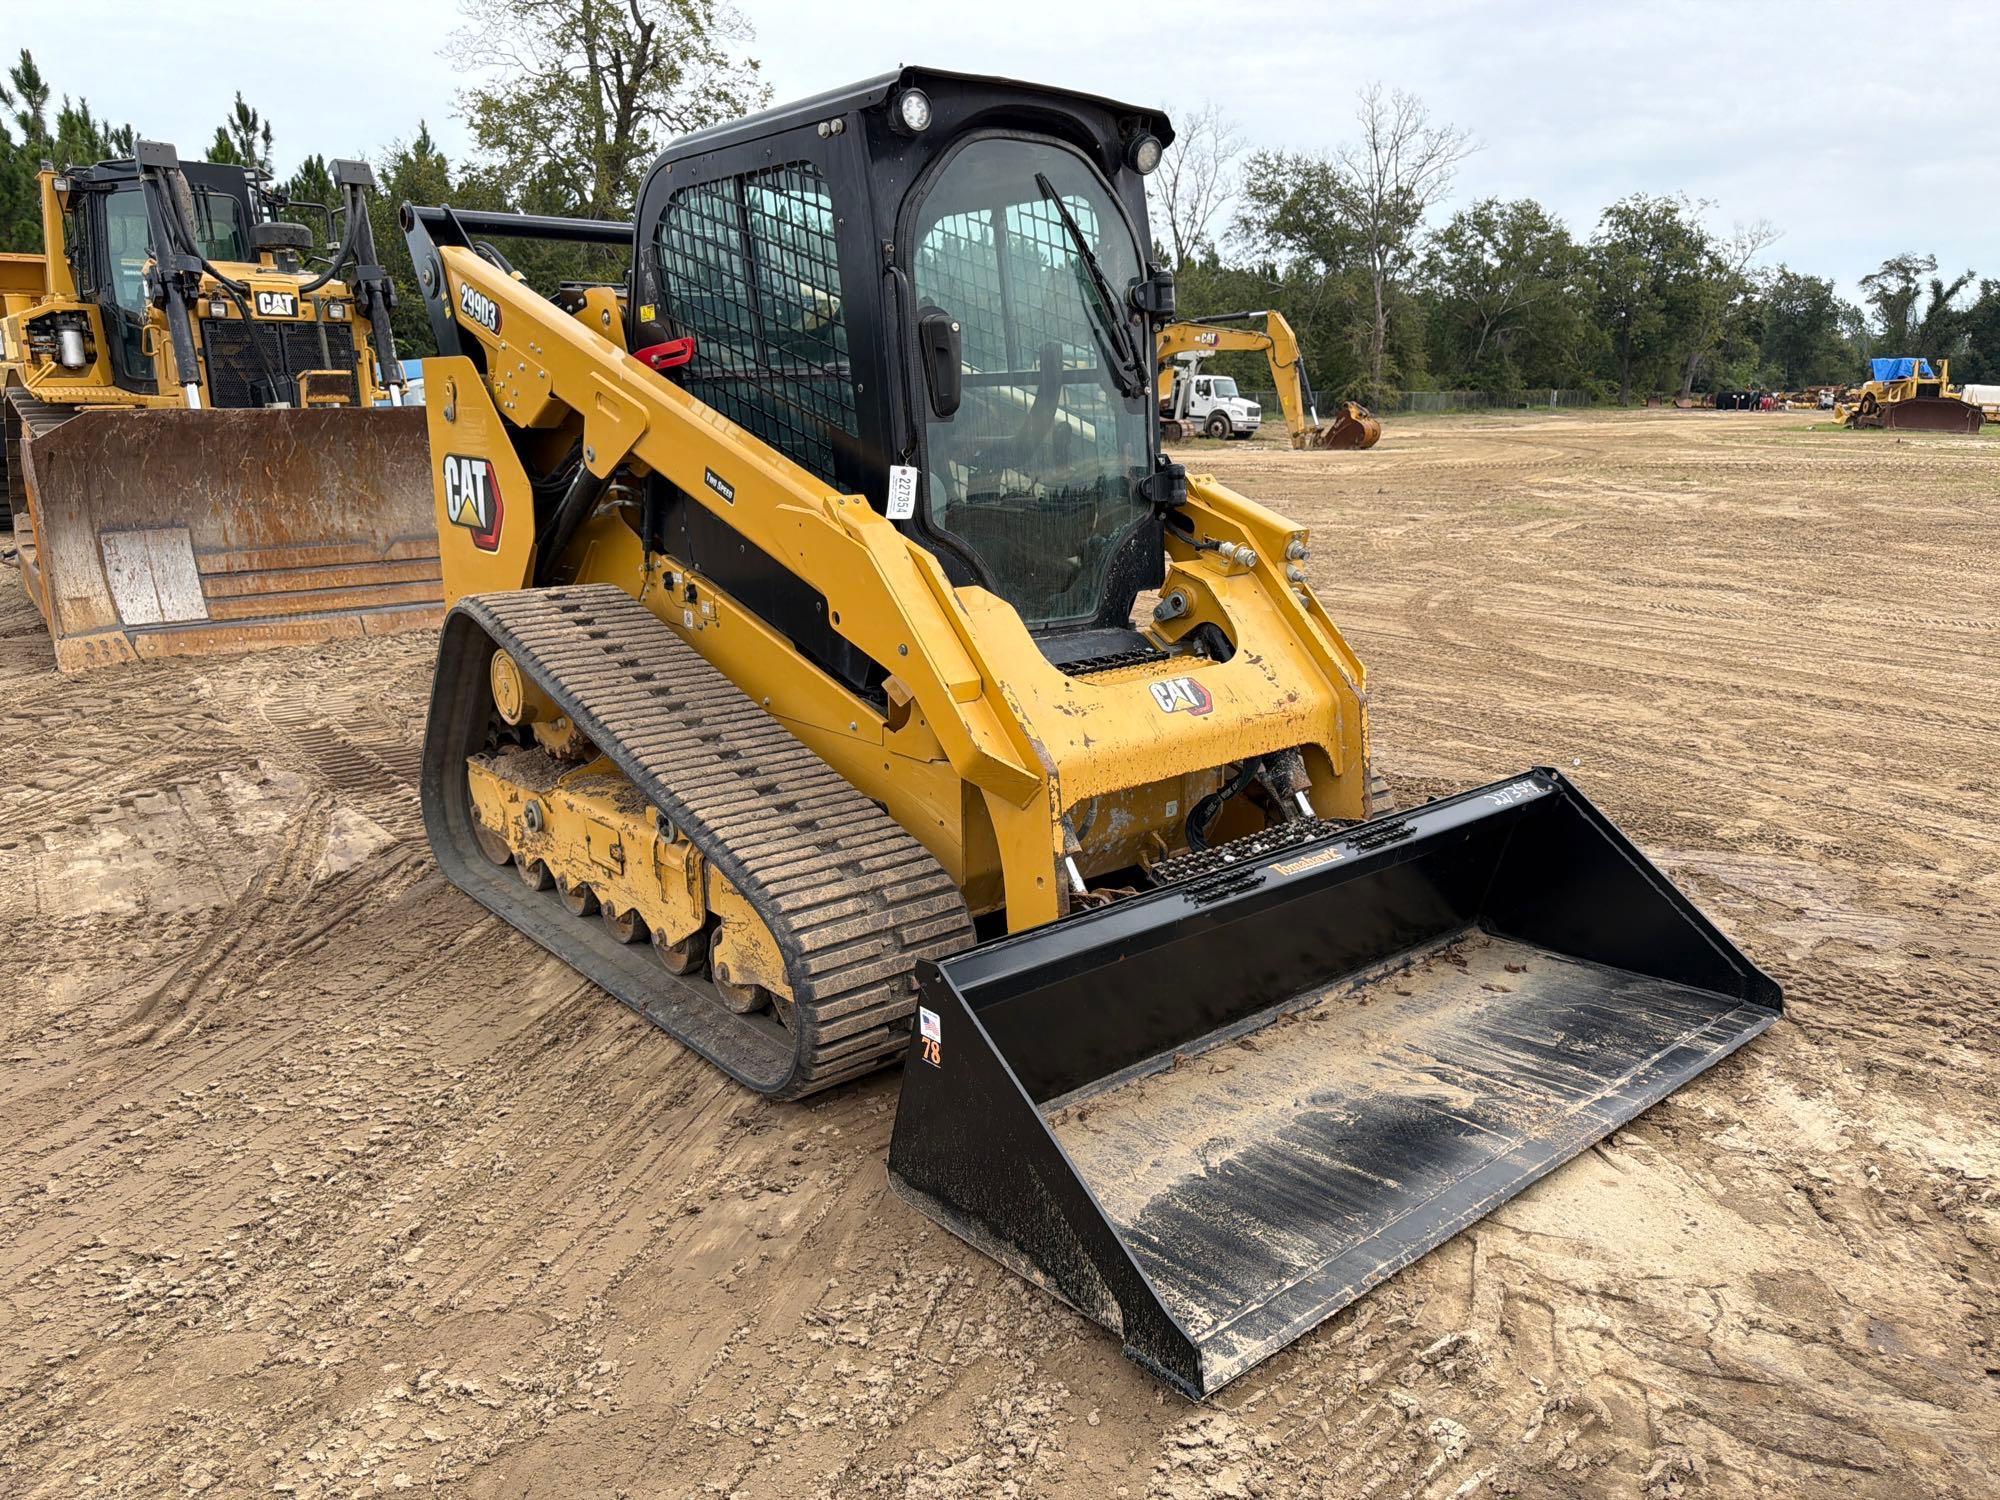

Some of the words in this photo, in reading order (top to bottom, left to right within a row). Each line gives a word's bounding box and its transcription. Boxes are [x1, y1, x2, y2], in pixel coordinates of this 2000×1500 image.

[258, 292, 294, 316] CAT
[461, 283, 496, 331] 299D3
[1201, 332, 1216, 344] CAT
[443, 455, 487, 529] CAT
[896, 477, 911, 513] 227354
[1149, 678, 1200, 713] CAT
[1268, 848, 1340, 876] Tomahawk
[921, 1036, 941, 1064] 78
